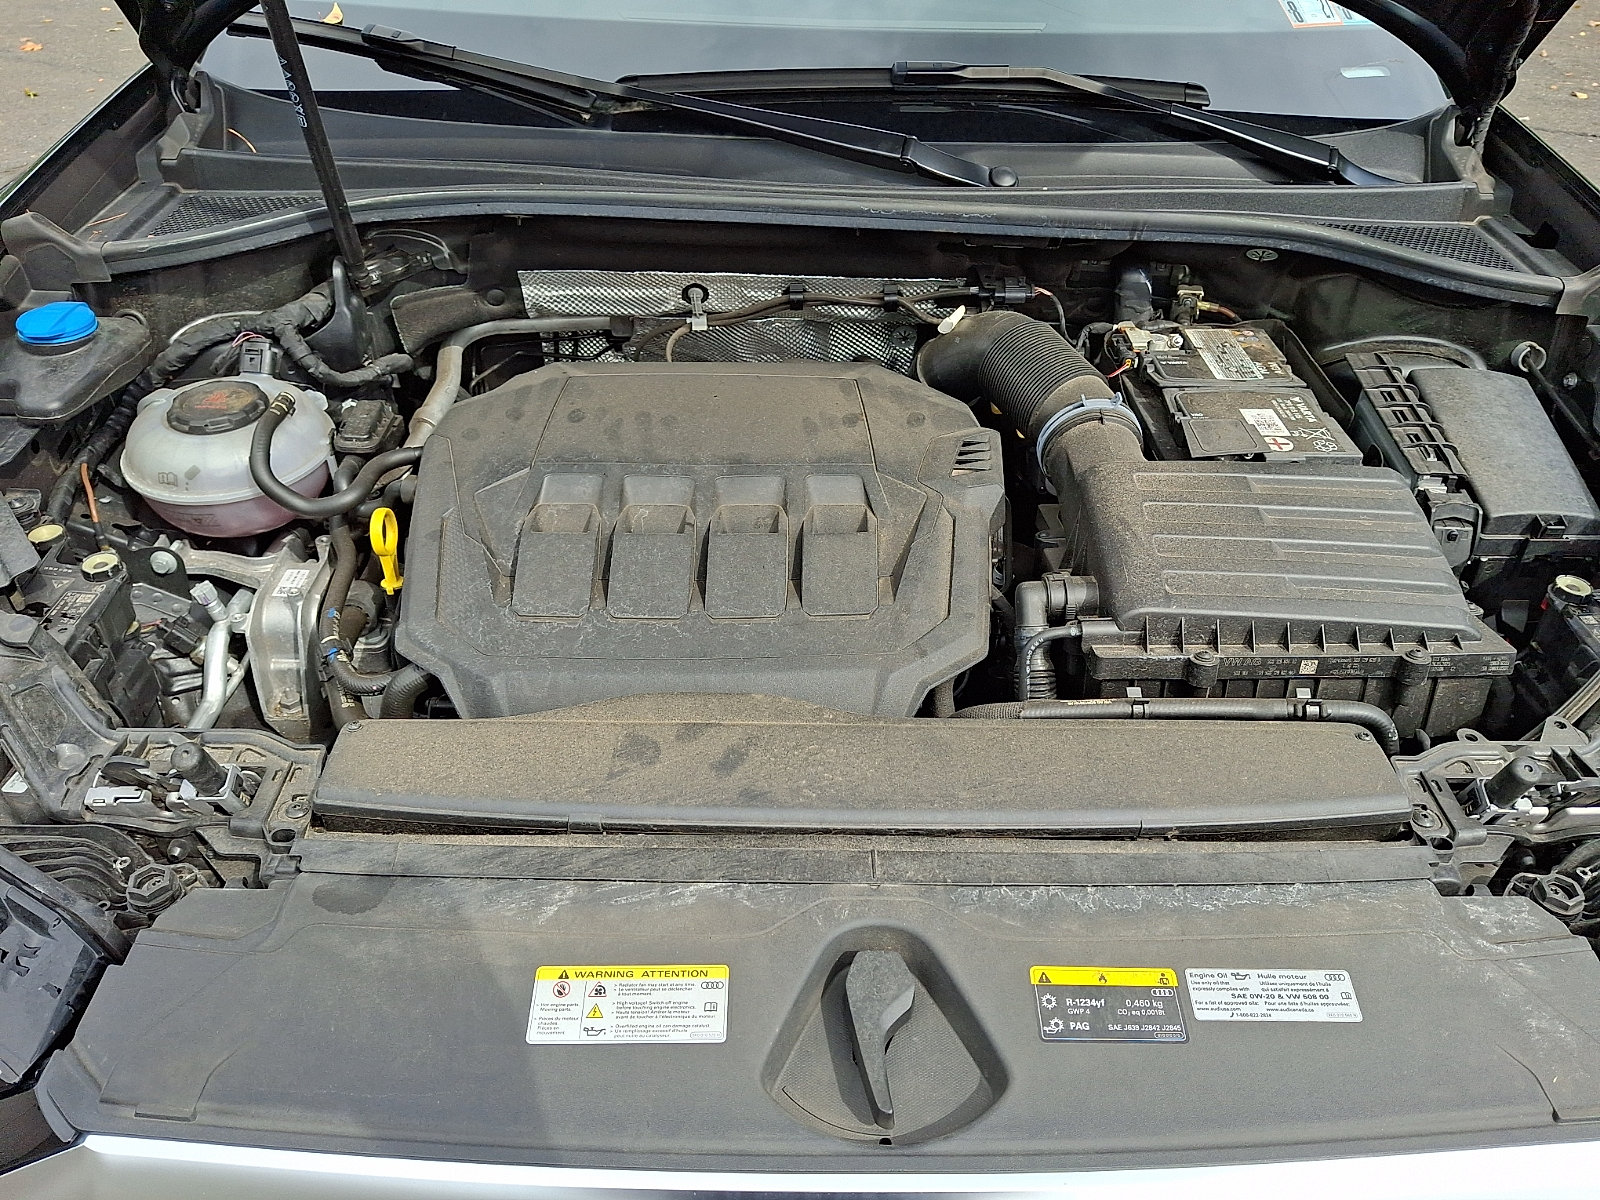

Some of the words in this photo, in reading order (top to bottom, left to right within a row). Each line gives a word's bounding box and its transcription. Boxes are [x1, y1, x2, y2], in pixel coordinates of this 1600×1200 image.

[1296, 400, 1318, 424] VARTA
[574, 970, 634, 978] WARNING
[641, 970, 708, 978] ATTENTION
[1065, 998, 1105, 1009] R-1234yf
[1152, 999, 1164, 1009] kg
[1069, 1021, 1090, 1031] PAG
